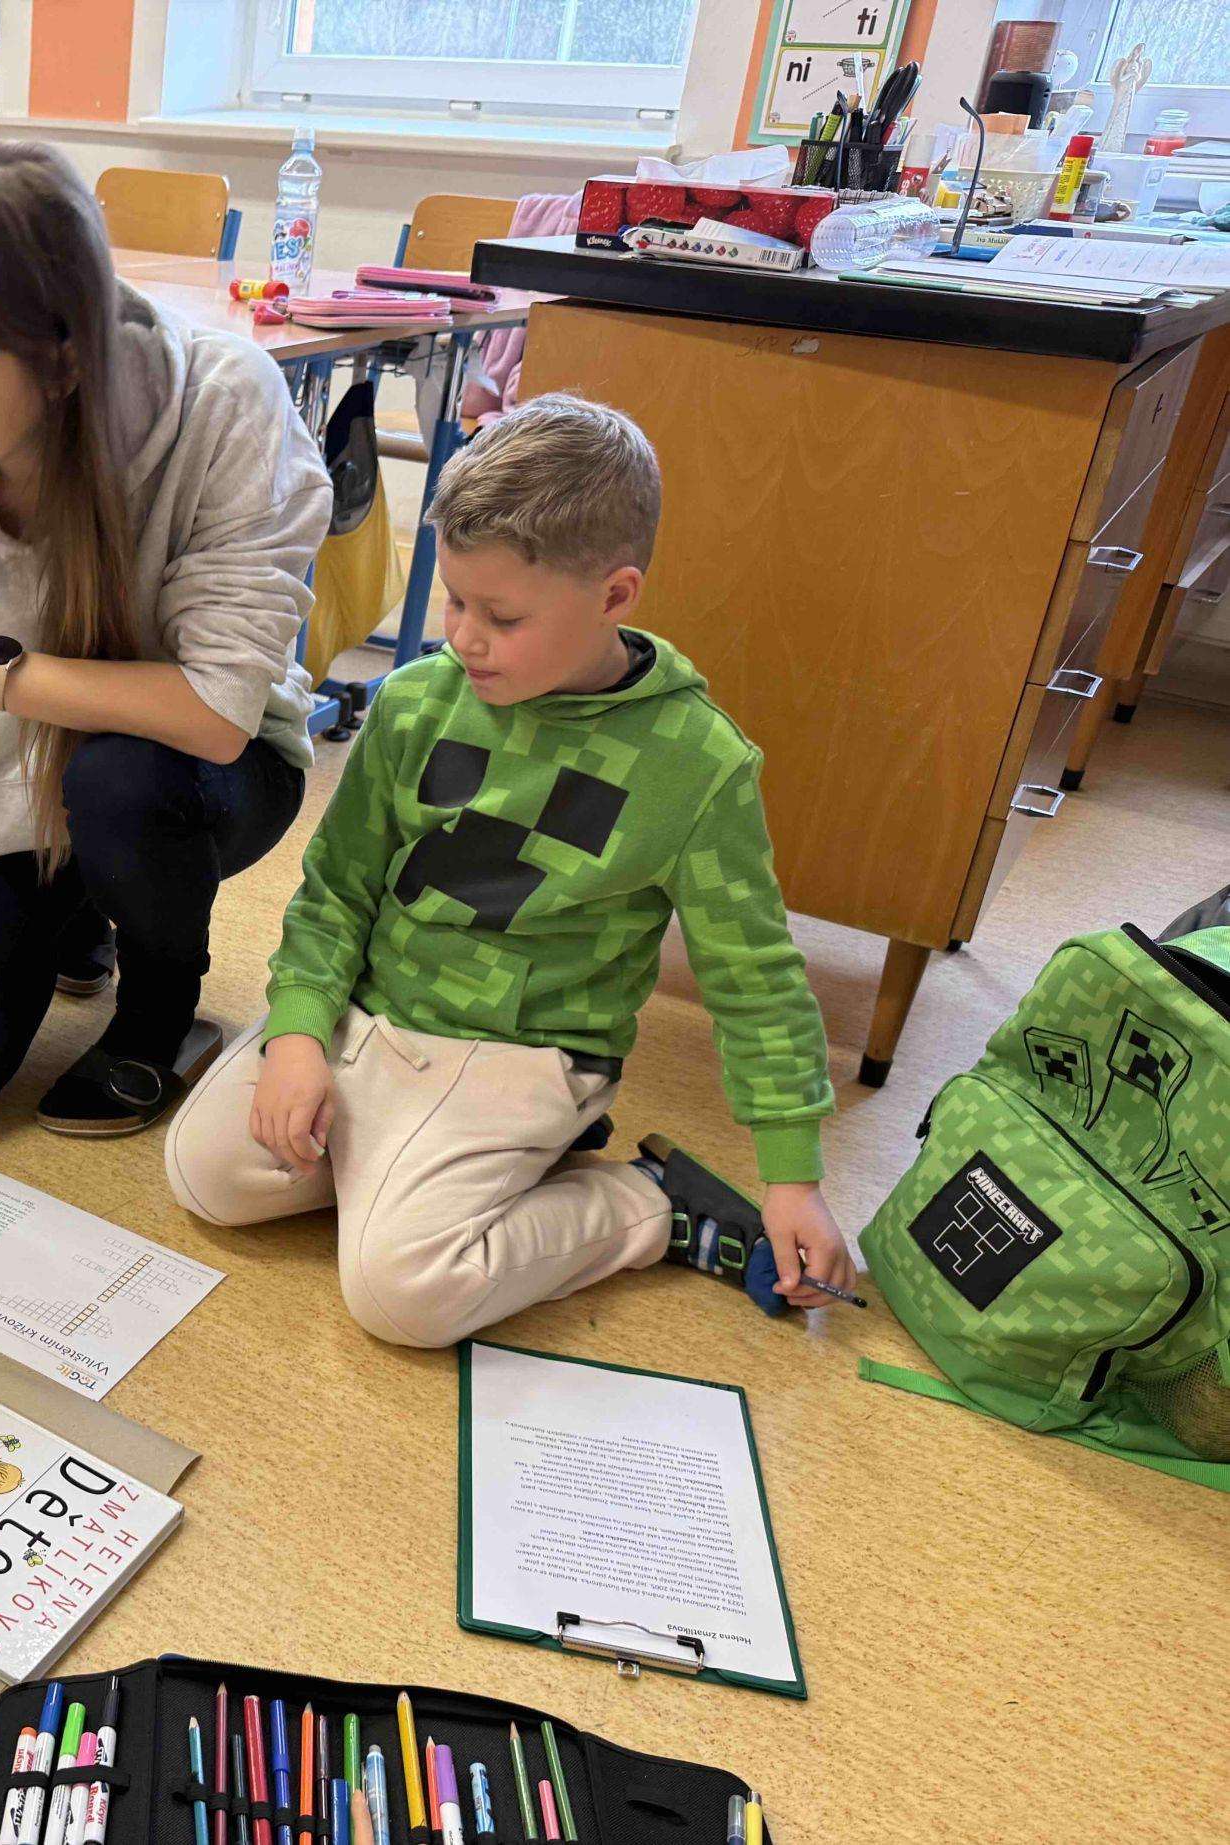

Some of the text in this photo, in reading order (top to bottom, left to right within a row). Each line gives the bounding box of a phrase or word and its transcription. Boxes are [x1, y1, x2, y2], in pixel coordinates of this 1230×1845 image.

[786, 57, 812, 82] ni
[586, 236, 612, 247] Kleenex
[968, 1168, 1042, 1243] MINECRAFT
[36, 1332, 113, 1375] Vyluštěním
[35, 1529, 139, 1631] HELENA
[666, 1623, 751, 1644] Helena Zmatlíková
